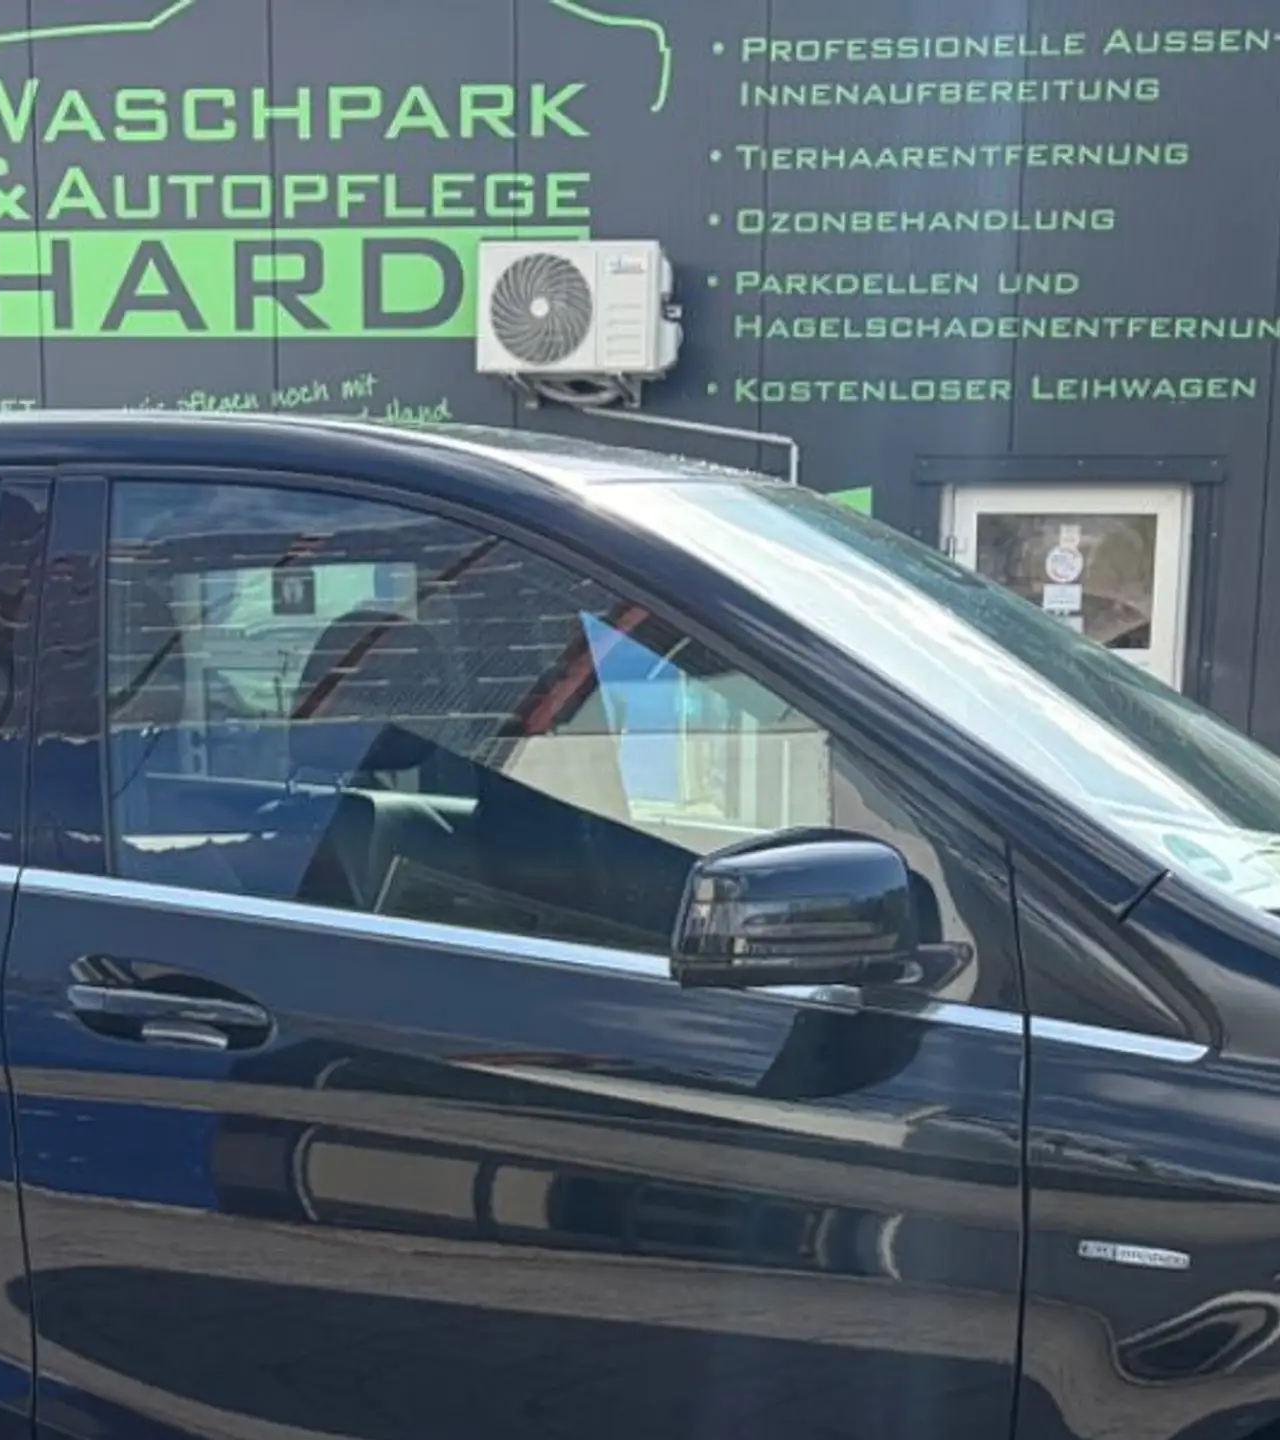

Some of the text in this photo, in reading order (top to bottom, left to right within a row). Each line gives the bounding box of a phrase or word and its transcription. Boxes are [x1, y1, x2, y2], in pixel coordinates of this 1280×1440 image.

[741, 32, 1086, 62] PROFESSIONELLE
[740, 76, 1161, 108] INNENAUFBEREITUNG
[735, 141, 1190, 172] TIERHAARENTFERNUNG
[736, 206, 1117, 236] OZONBEHANDLUNG
[735, 270, 1080, 297] PARKDELLEN UND
[735, 375, 1258, 404] KOSTENLOSER LEIHWAGEN
